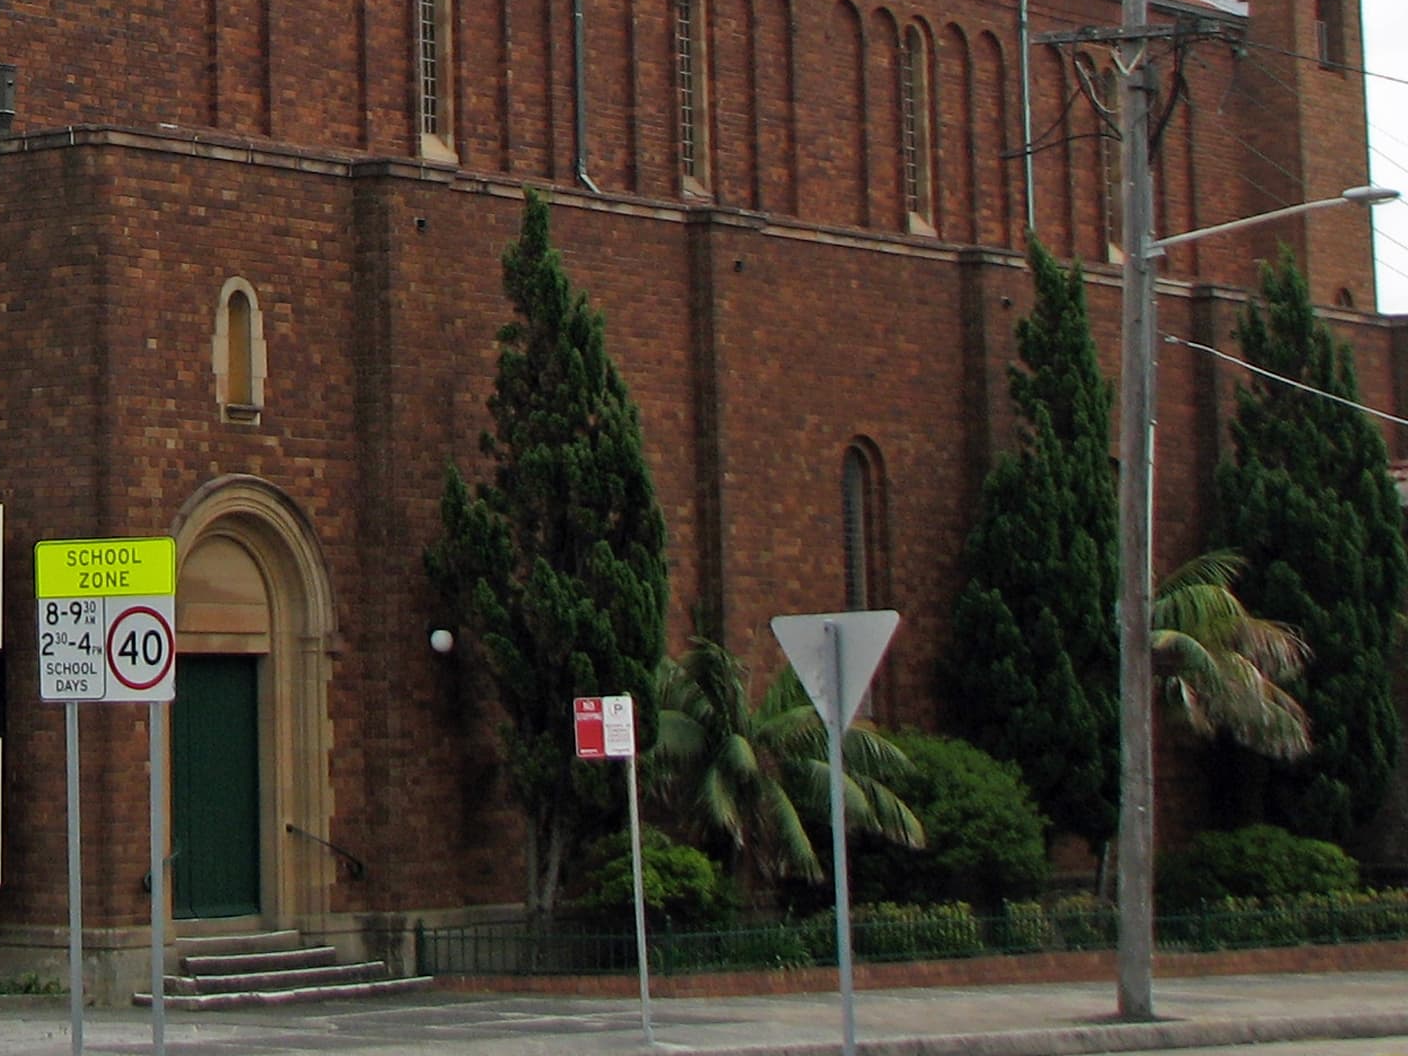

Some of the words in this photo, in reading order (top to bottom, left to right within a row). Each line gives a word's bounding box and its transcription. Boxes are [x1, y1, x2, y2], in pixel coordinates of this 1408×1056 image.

[67, 548, 142, 566] SCHOOL
[79, 571, 130, 589] ZONE
[118, 630, 162, 665] 40
[47, 662, 97, 675] SCHOOL
[56, 679, 88, 692] DAYS
